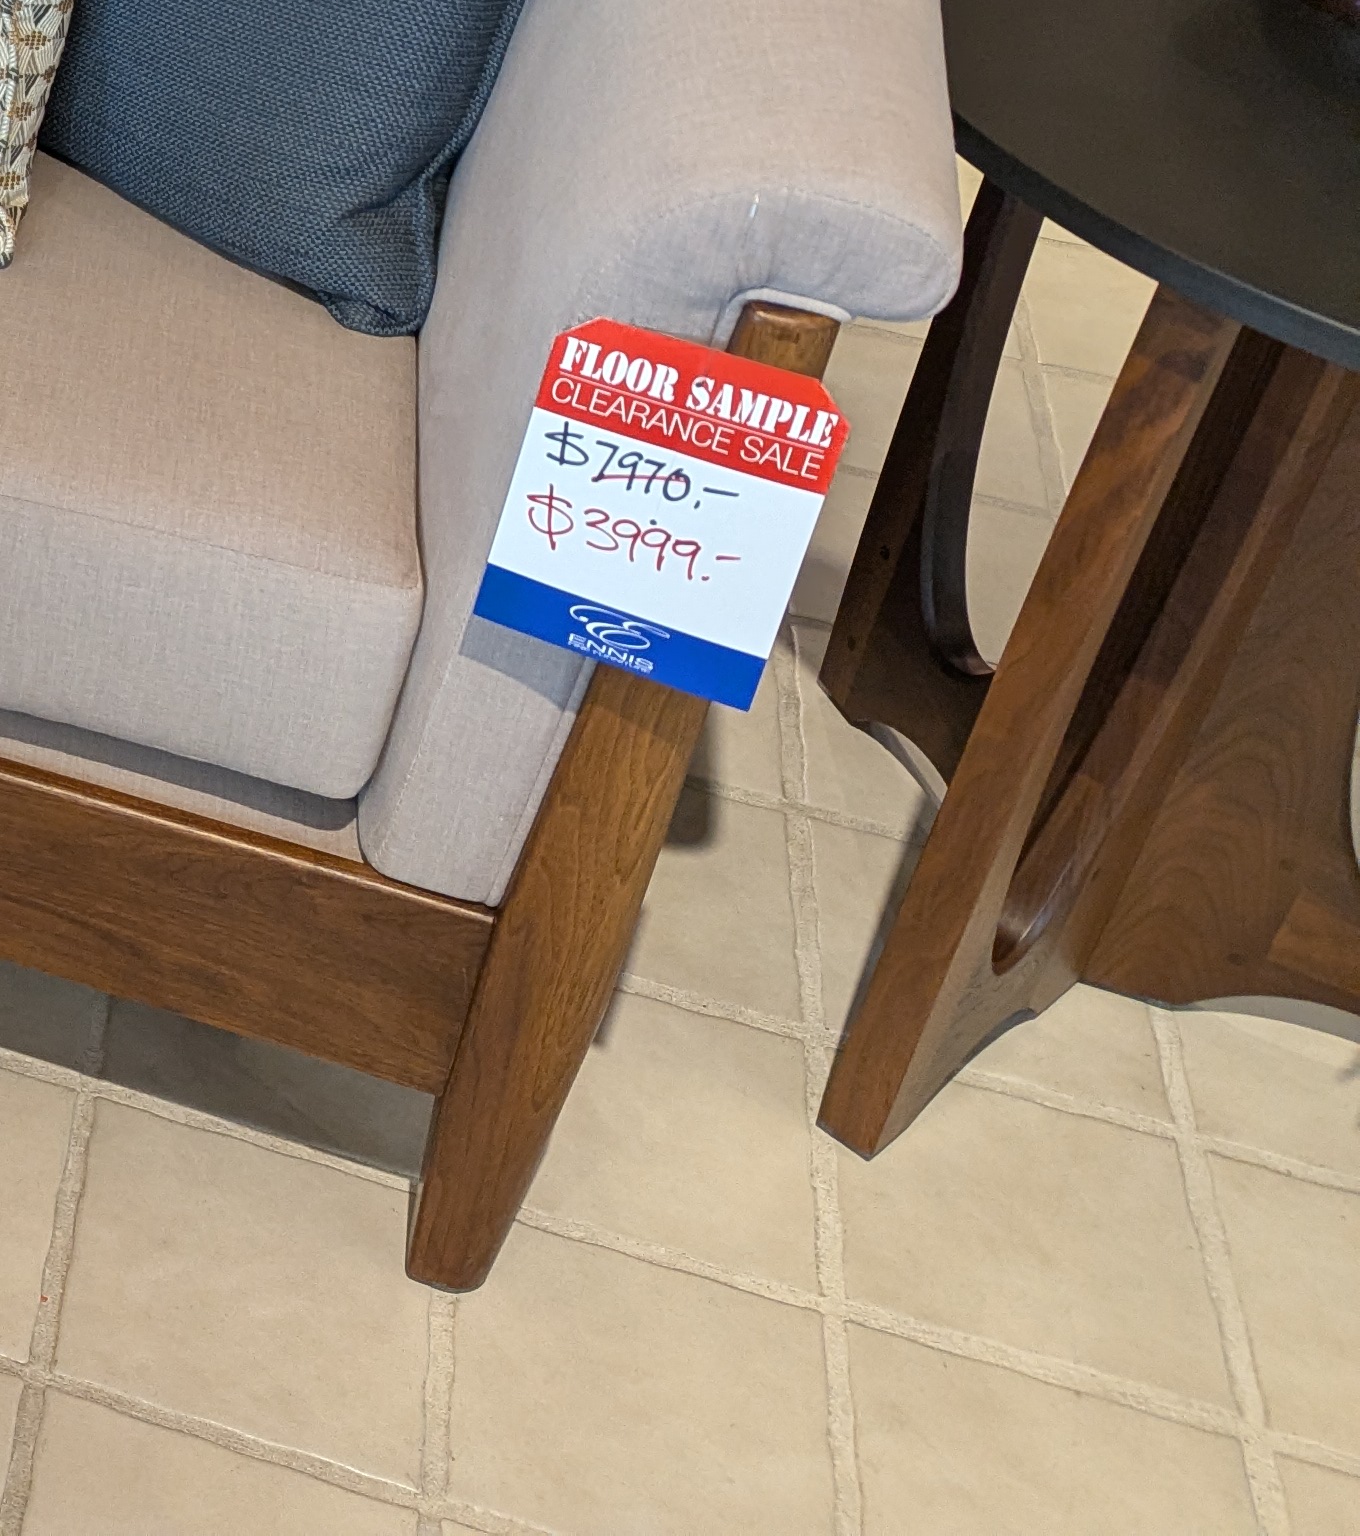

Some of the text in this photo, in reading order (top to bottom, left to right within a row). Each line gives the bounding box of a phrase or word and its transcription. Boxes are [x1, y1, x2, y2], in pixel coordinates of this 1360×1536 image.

[552, 377, 825, 480] CLEARANCE SALE
[559, 337, 838, 449] FLOOR SAMPLE
[568, 633, 654, 669] ENNIS
